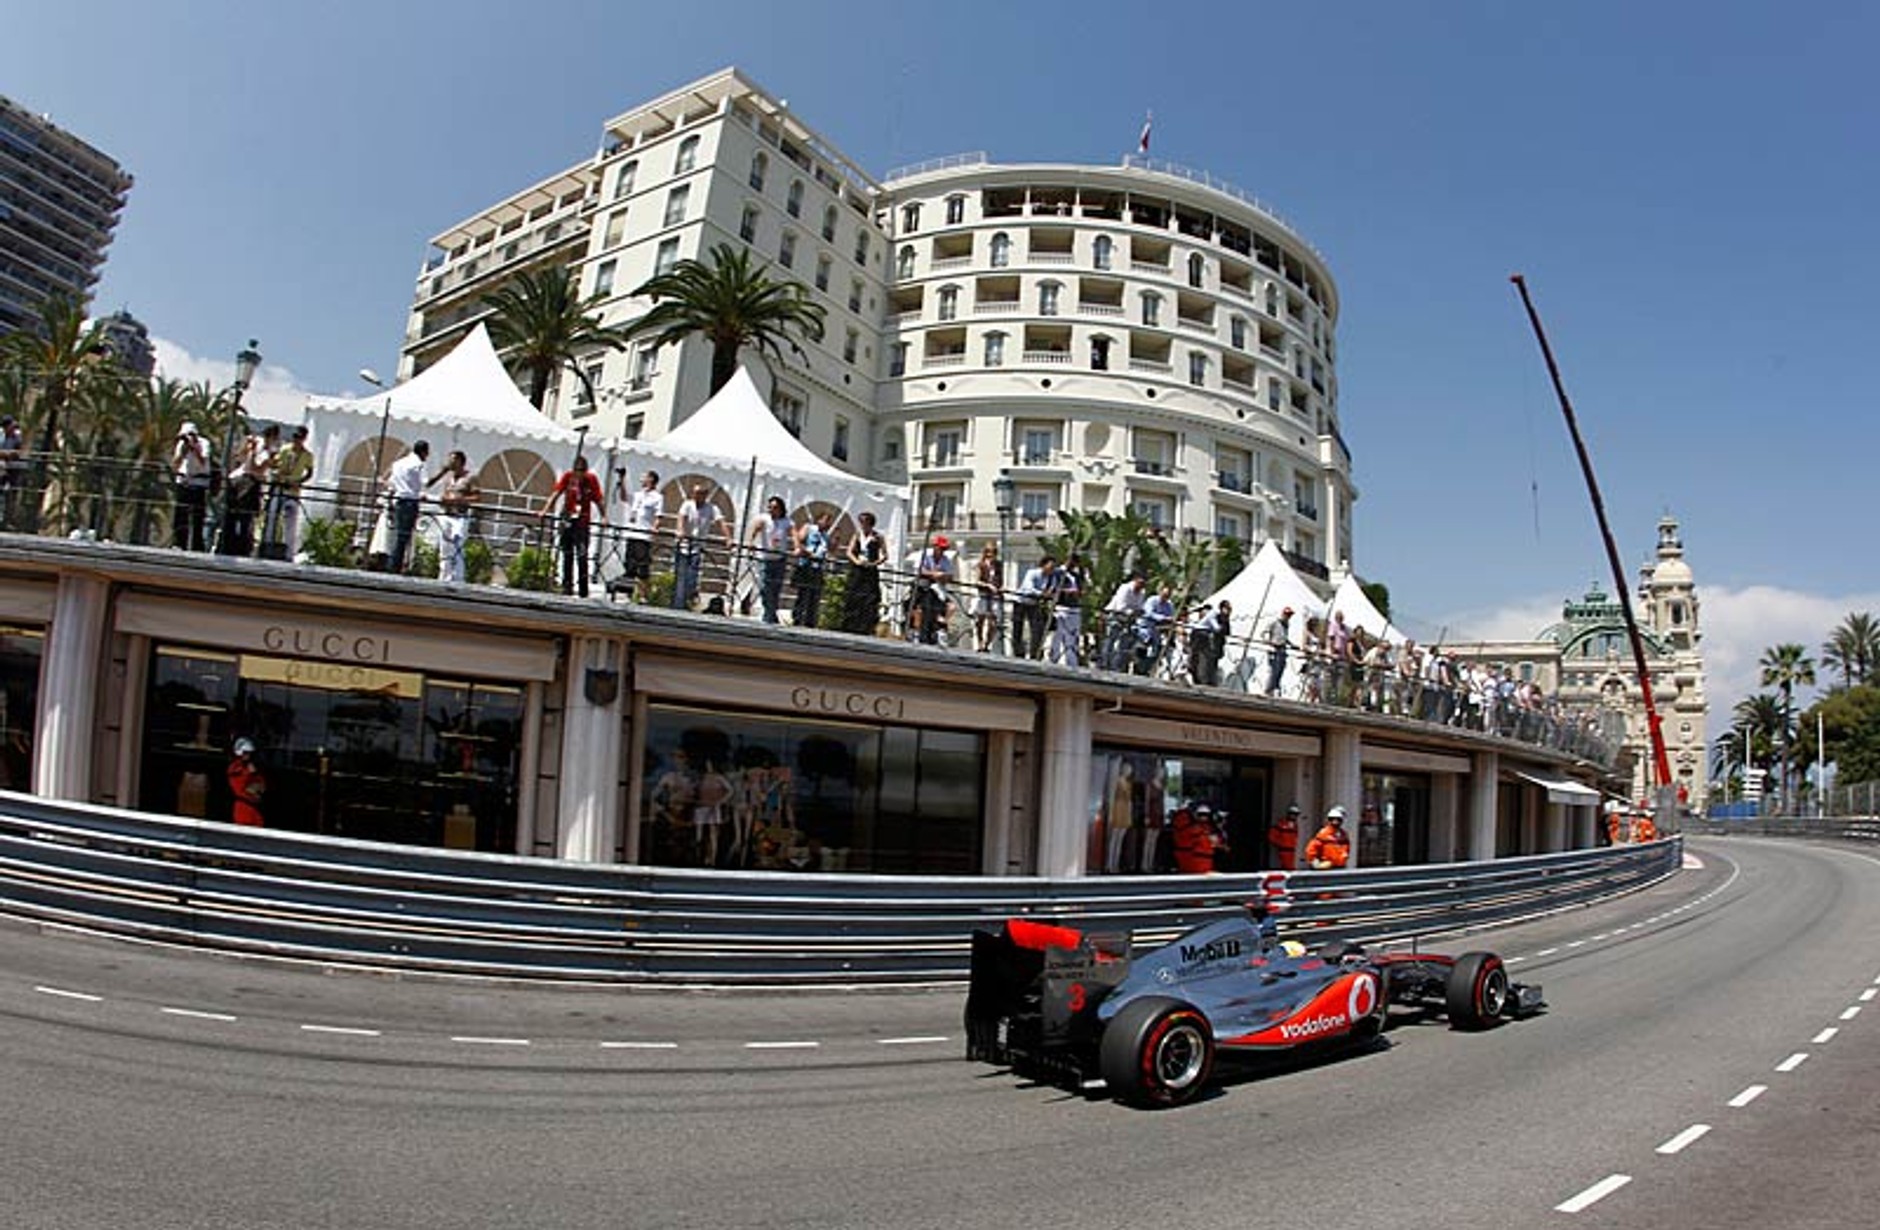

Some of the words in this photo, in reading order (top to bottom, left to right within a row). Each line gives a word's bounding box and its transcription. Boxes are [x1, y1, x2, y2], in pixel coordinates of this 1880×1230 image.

[263, 626, 389, 662] GUCCI
[791, 686, 904, 719] GUCCI
[1066, 983, 1087, 1013] 3
[1280, 1013, 1346, 1039] vodafone
